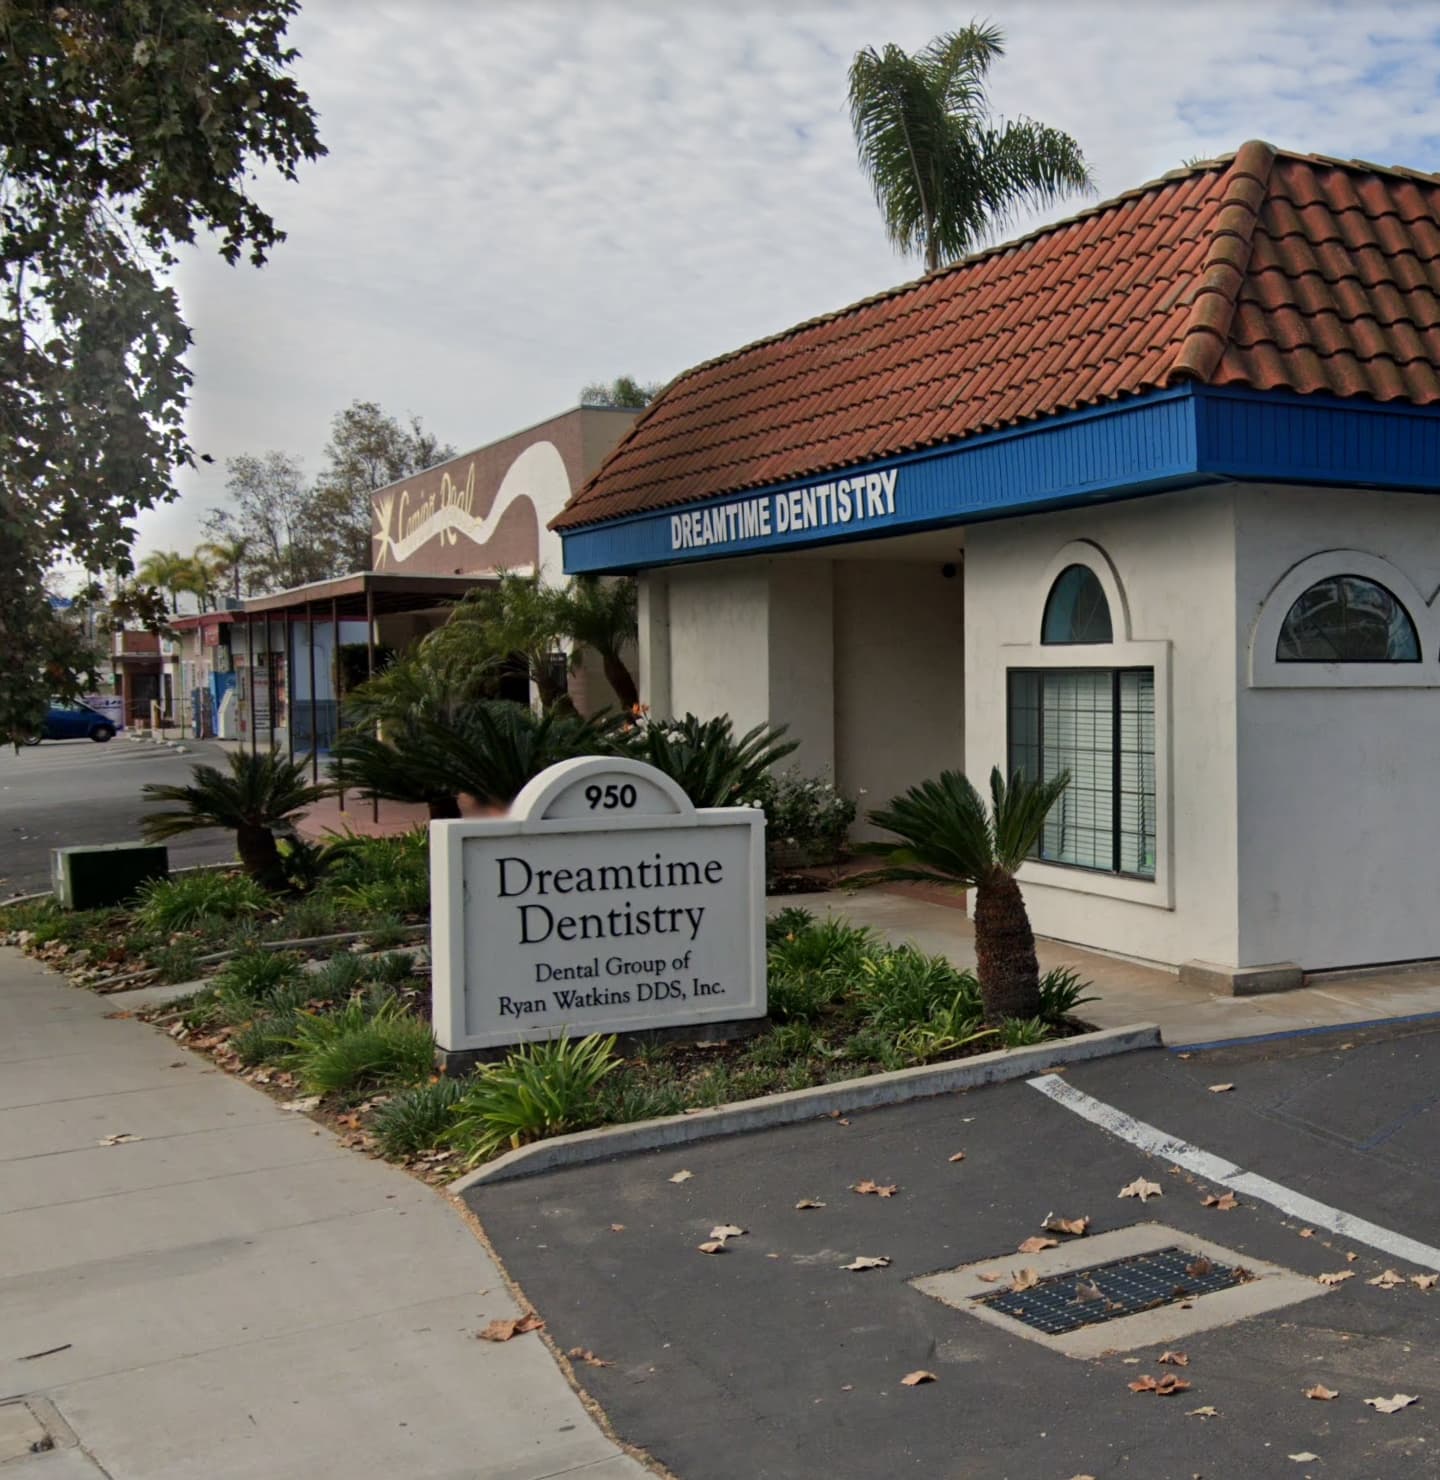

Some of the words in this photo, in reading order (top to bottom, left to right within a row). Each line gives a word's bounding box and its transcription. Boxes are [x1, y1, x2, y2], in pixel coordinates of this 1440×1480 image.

[671, 497, 771, 550] DREAMTIME
[776, 468, 898, 533] DENTISTRY
[584, 783, 637, 809] 950
[495, 853, 723, 898] Dreamtime
[516, 901, 706, 945] Dentistry
[535, 957, 600, 983] Dental
[605, 956, 666, 978] Group
[671, 949, 693, 971] of
[498, 996, 547, 1019] Ryan
[552, 987, 631, 1010] Watkins
[636, 979, 687, 1002] DDS,
[692, 977, 726, 997] Inc.
